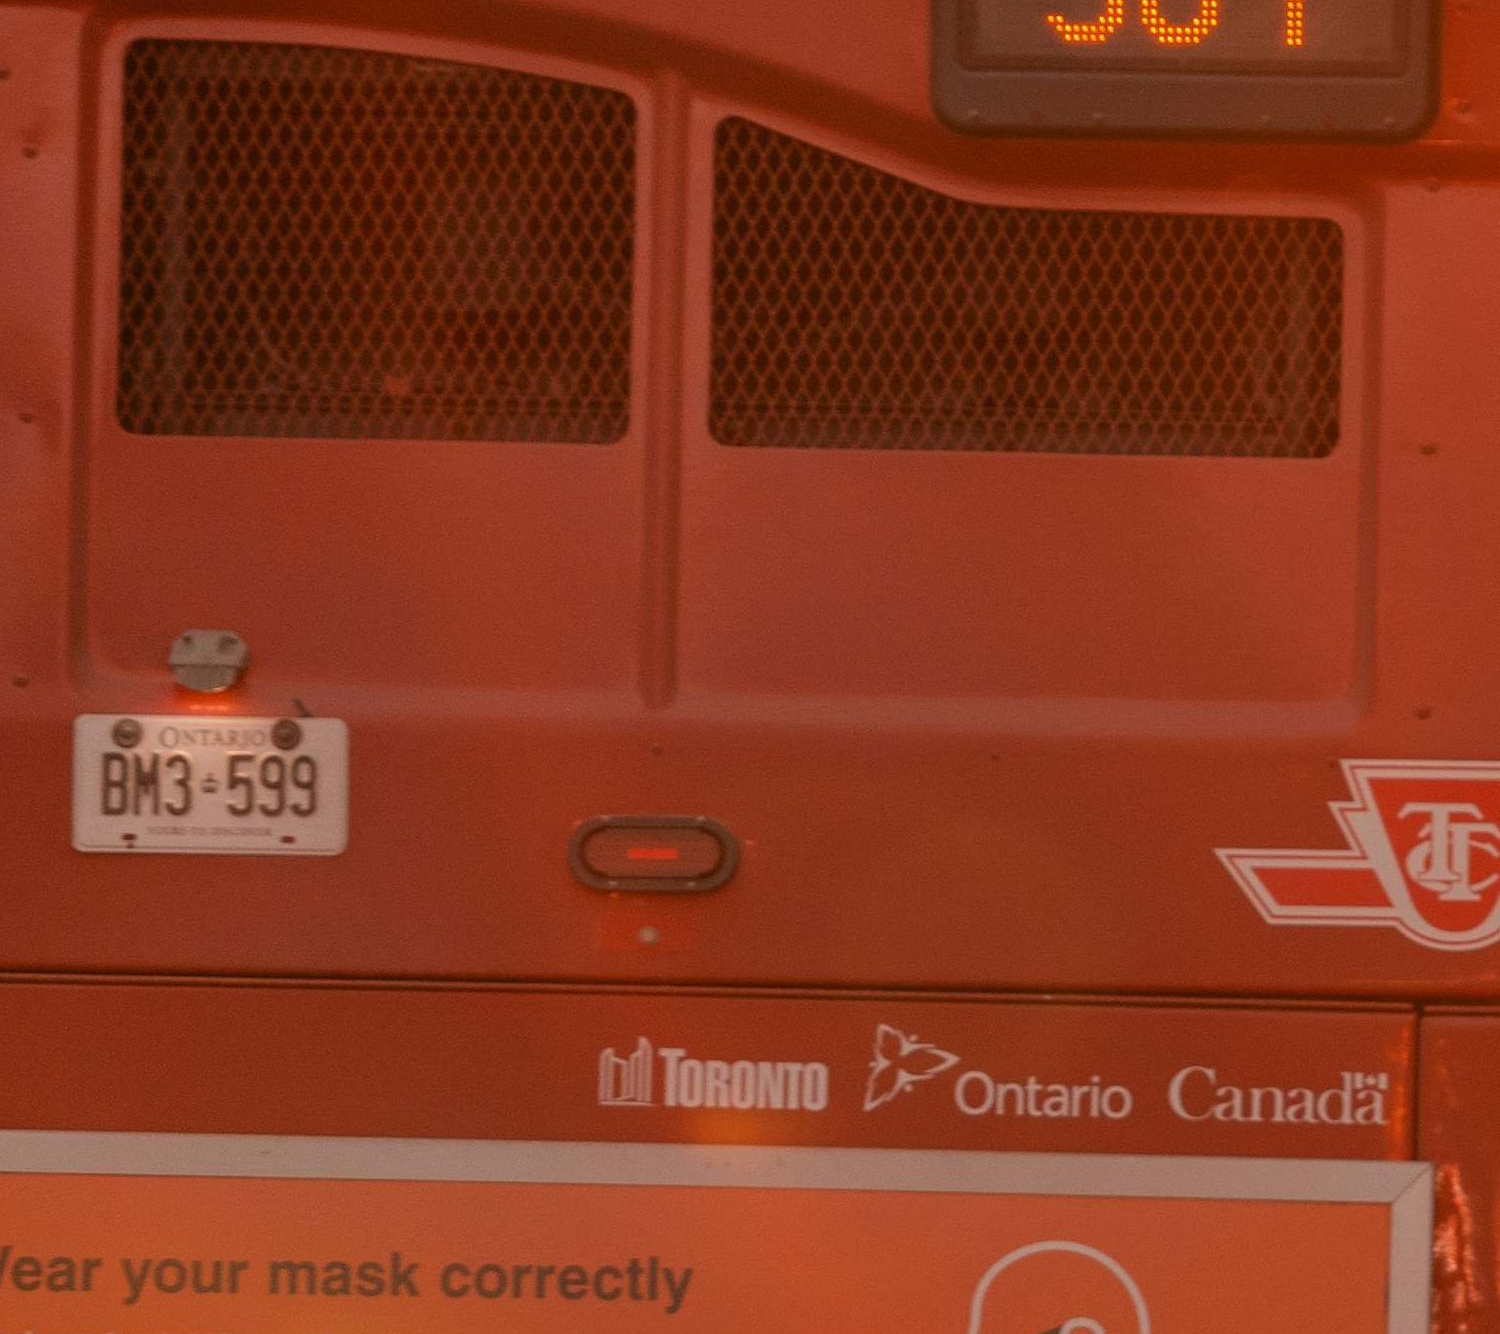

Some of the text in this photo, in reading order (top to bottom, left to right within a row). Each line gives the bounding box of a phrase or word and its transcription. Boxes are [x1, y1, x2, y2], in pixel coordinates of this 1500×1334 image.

[159, 726, 267, 748] ONTARIO
[661, 1047, 830, 1113] TORONTO
[954, 1070, 1133, 1120] Ontario
[1167, 1065, 1391, 1127] Canada
[121, 1257, 249, 1305] your
[267, 1251, 421, 1297] mask
[440, 1255, 694, 1315] correctly
